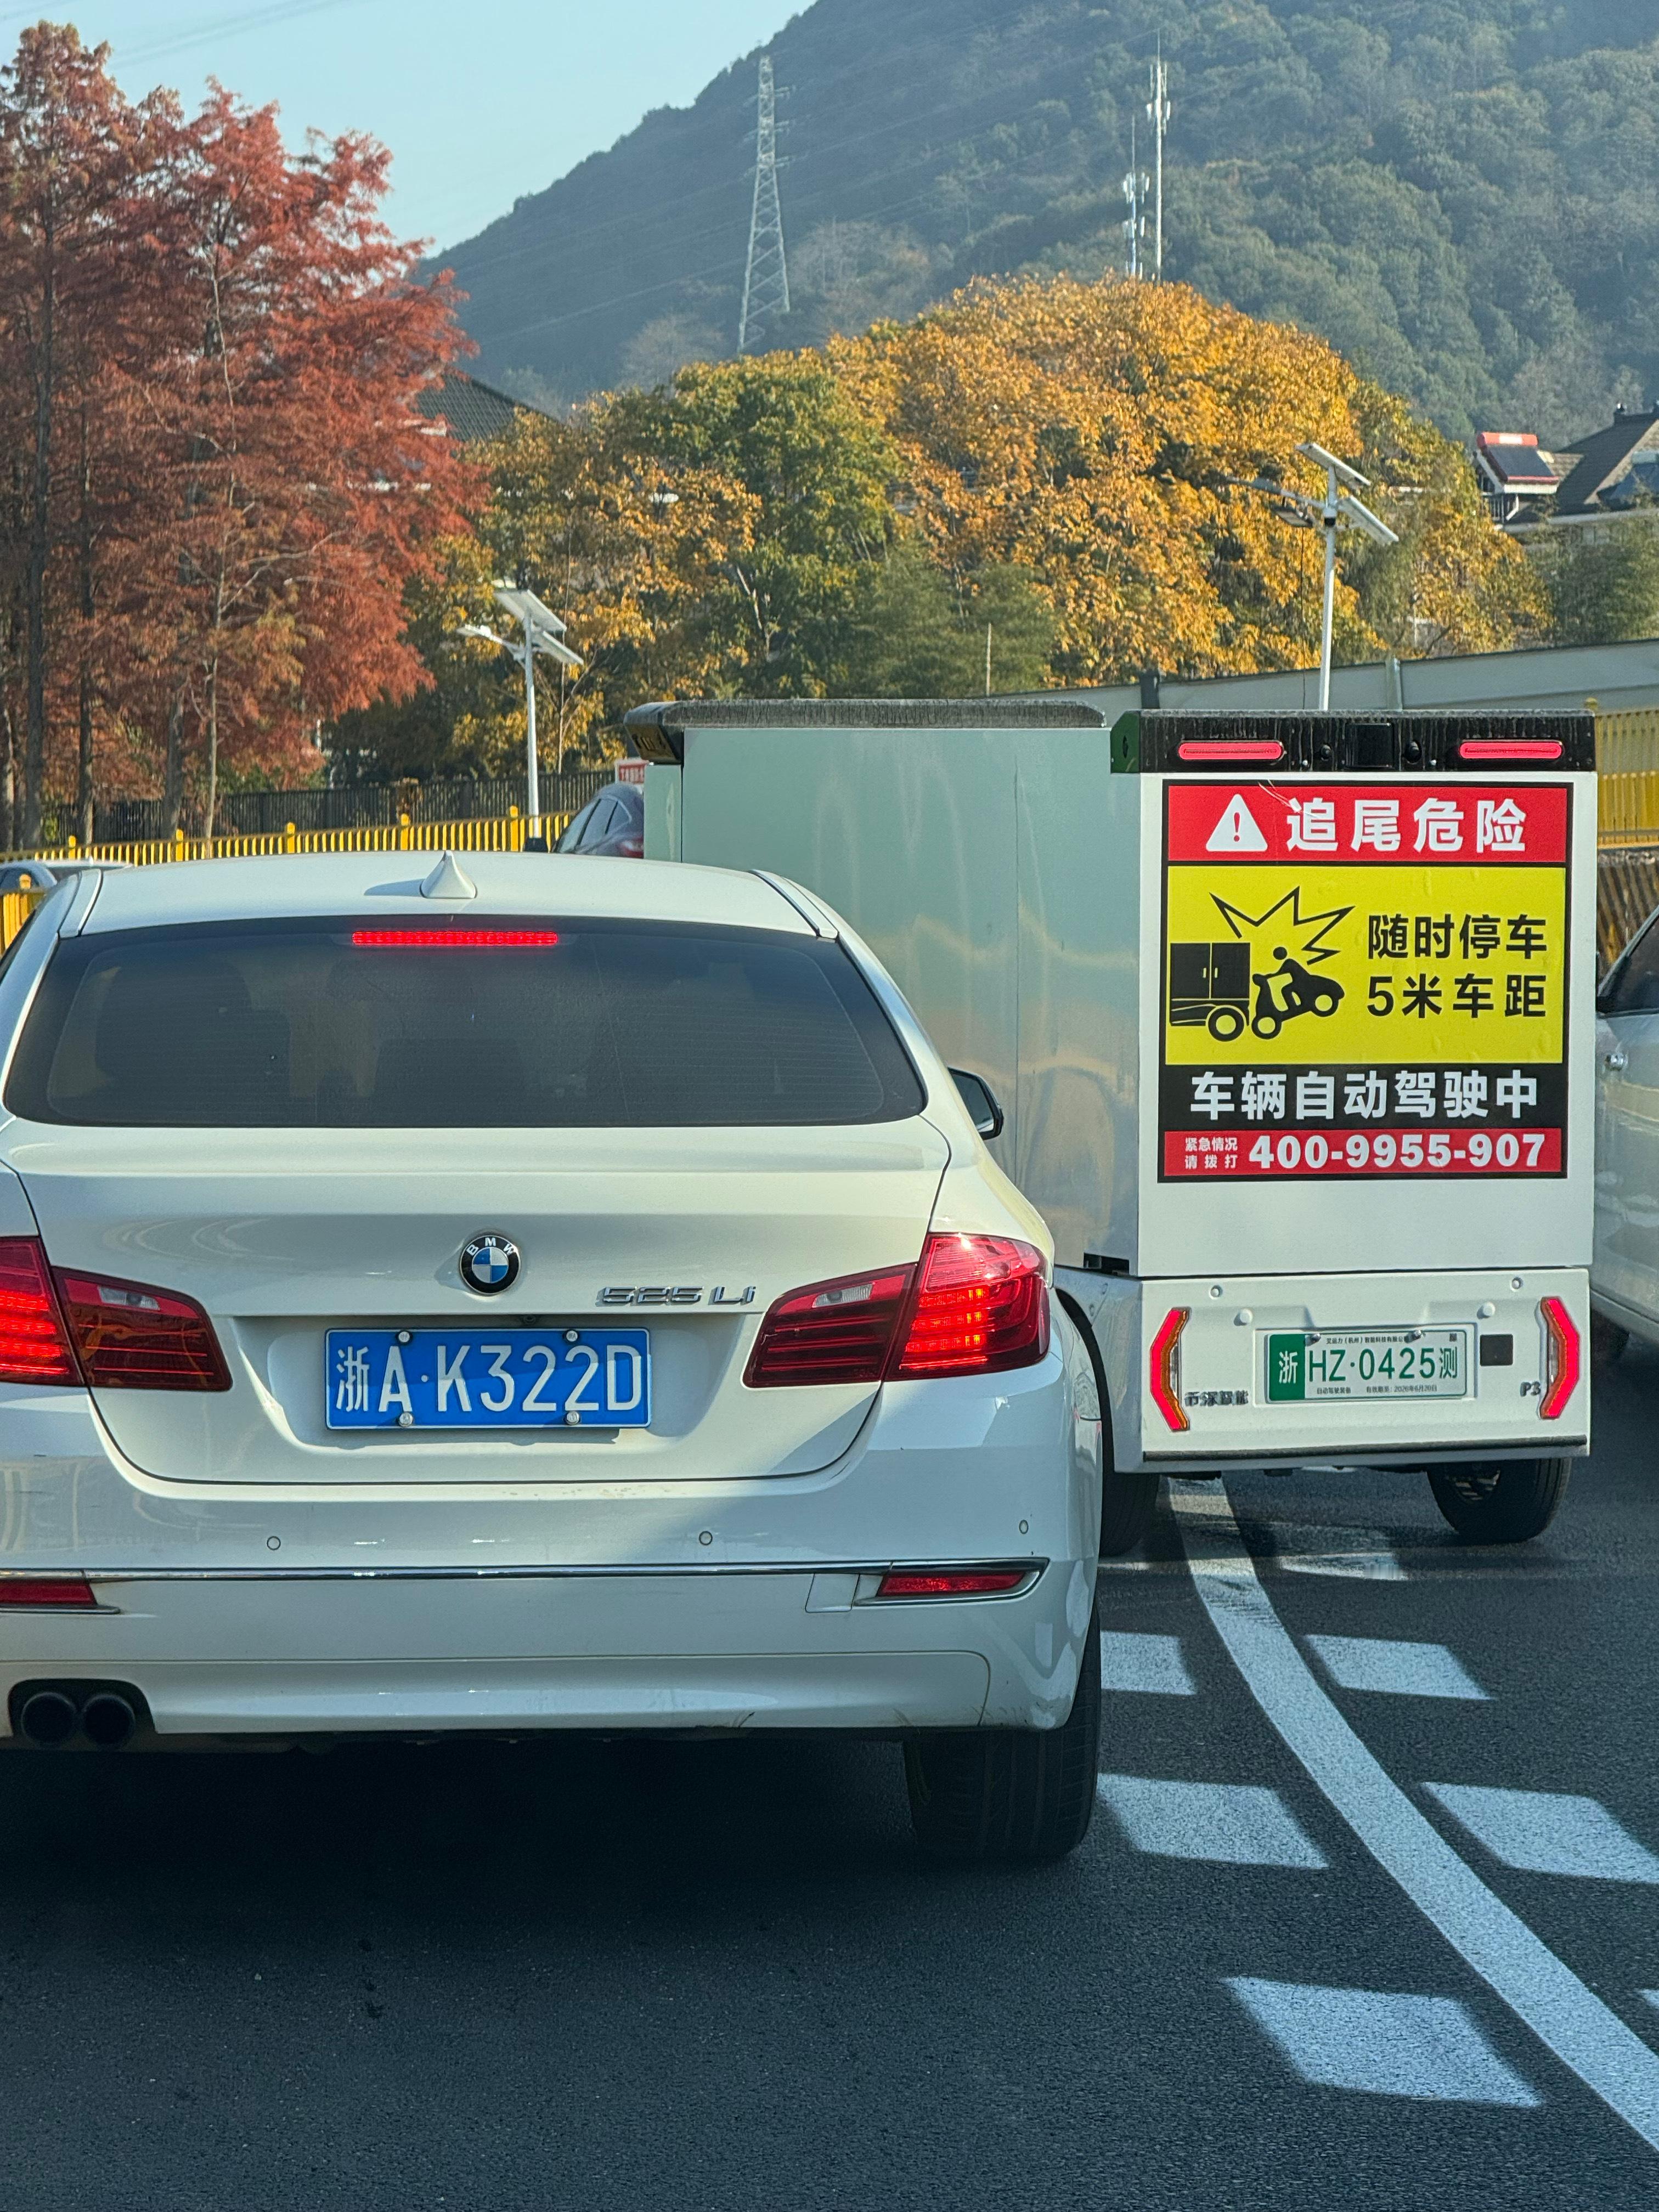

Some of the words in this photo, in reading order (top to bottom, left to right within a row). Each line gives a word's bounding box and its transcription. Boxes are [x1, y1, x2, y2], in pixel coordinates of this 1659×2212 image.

[1286, 797, 1527, 854] 追尾危险
[1367, 913, 1548, 960] 随时停车
[1367, 973, 1547, 1019] 5米车距
[1189, 1070, 1538, 1121] 车辆自动驾驶中
[1185, 1137, 1238, 1152] 紧急情况
[1249, 1134, 1546, 1169] 400-9955-907
[466, 1237, 517, 1256] BMW
[602, 1286, 703, 1304] 525
[713, 1285, 757, 1304] Li
[336, 1345, 642, 1413] 浙A·K322D
[1520, 1381, 1541, 1397] P3
